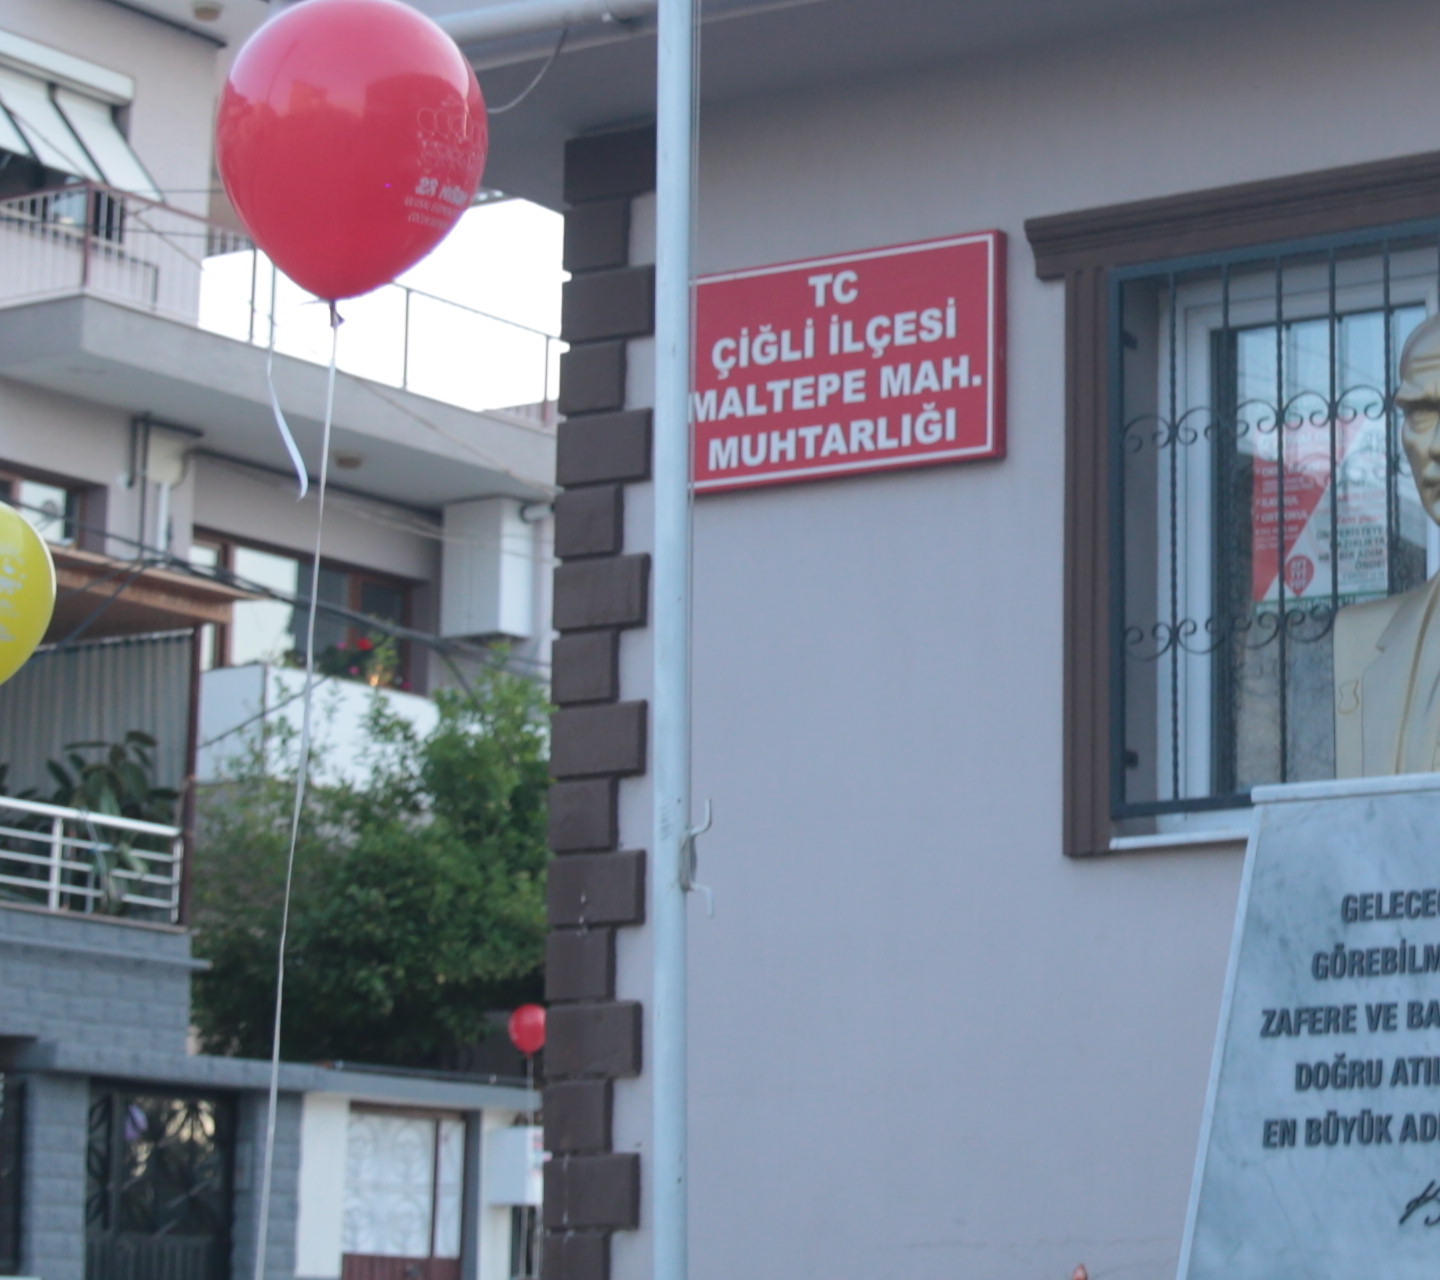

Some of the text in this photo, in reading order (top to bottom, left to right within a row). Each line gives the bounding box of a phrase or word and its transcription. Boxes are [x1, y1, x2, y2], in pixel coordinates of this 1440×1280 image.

[807, 270, 859, 308] TC
[711, 296, 957, 381] ÇİĞLİ İLÇESİ
[688, 354, 983, 423] MALTEPE MAH.
[708, 401, 957, 472] MUHTARLIĞI
[1259, 1004, 1358, 1039] ZAFERE
[1365, 1002, 1398, 1033] VE
[1294, 1053, 1384, 1092] DOĞRU
[1262, 1118, 1297, 1150] EN
[1304, 1109, 1393, 1148] BÜYÜK
